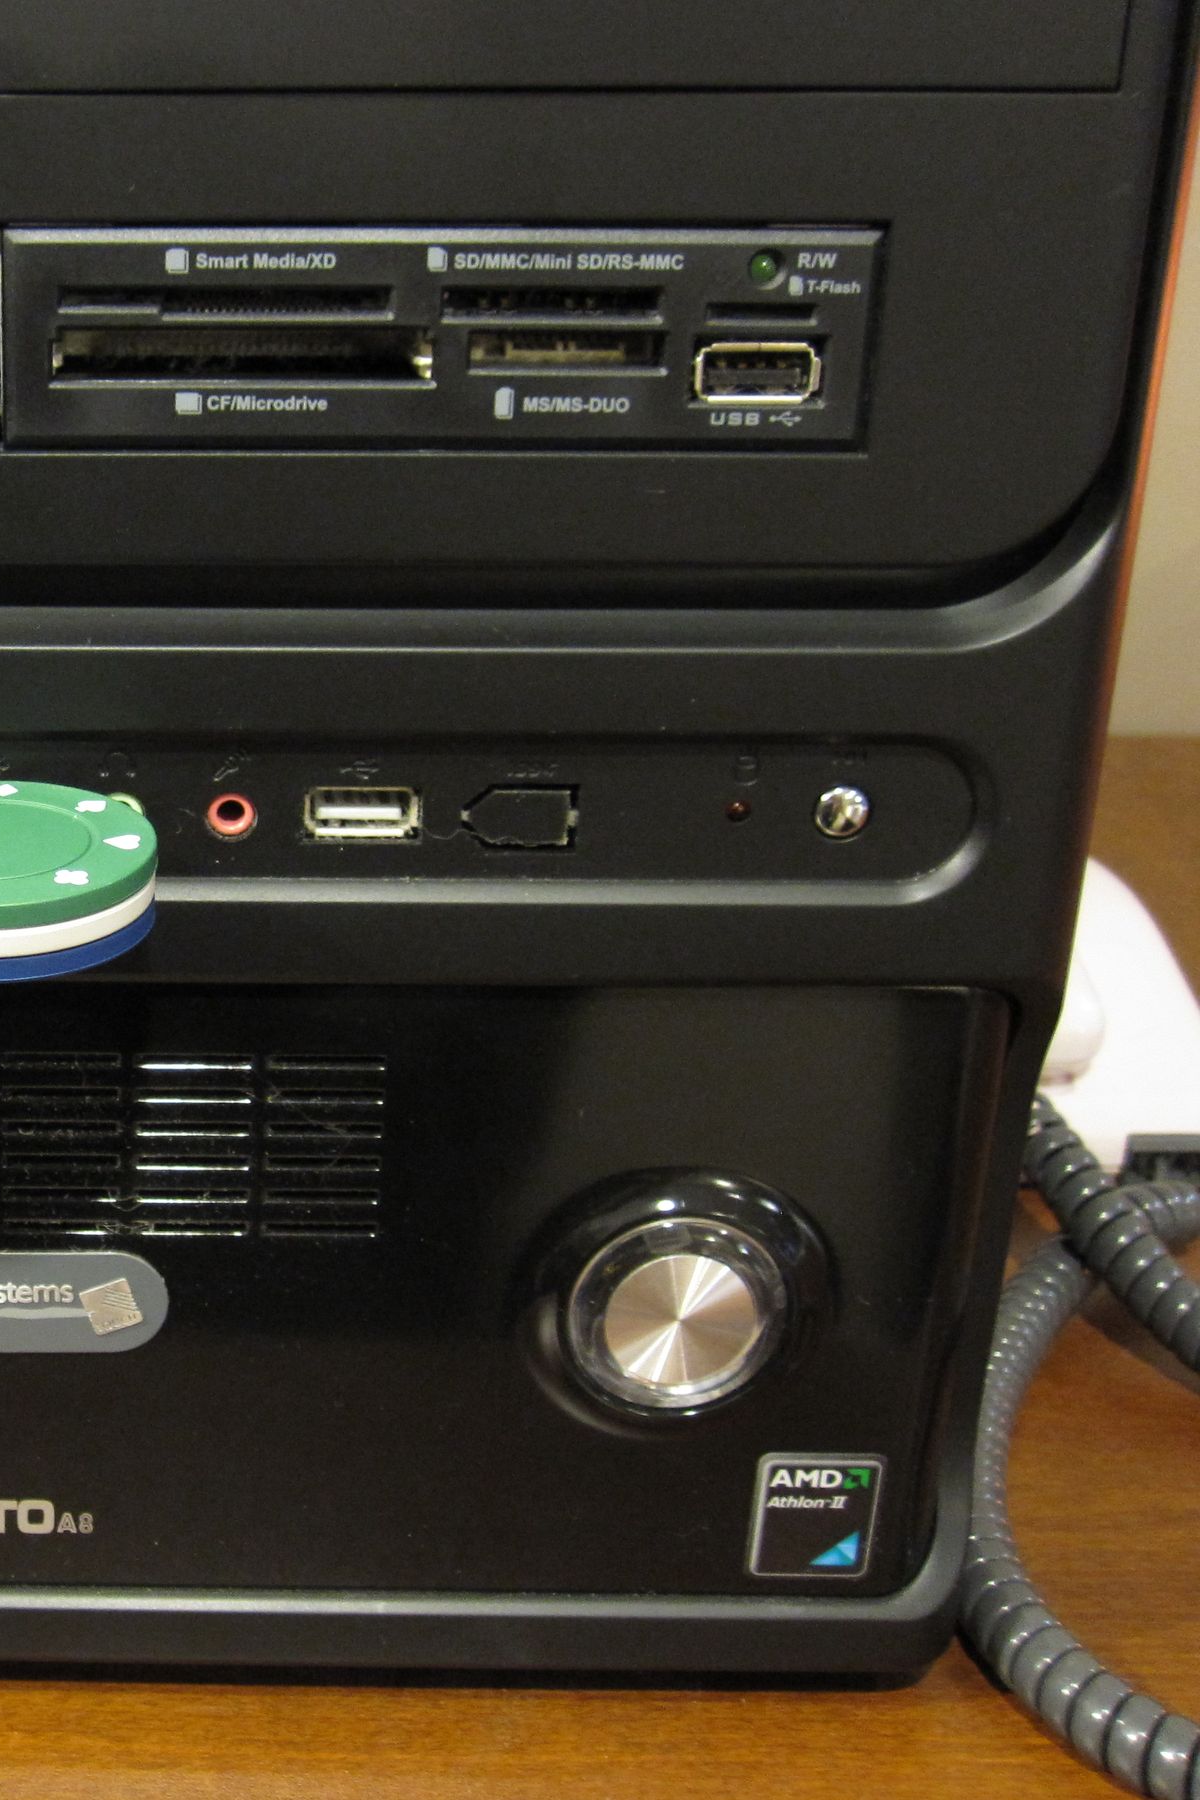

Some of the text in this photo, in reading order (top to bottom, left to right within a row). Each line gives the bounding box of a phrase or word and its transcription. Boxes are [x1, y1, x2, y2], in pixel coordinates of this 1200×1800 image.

[195, 252, 337, 269] Smart Media/XD
[454, 252, 685, 270] SD/MMC/Mini SD/RS-MMC
[797, 252, 838, 269] R/W
[806, 279, 861, 294] T-Flash
[206, 395, 329, 412] CF/Microdrive
[522, 396, 631, 414] MS/MS-DUO
[709, 411, 761, 427] USB
[769, 1469, 843, 1488] AMD
